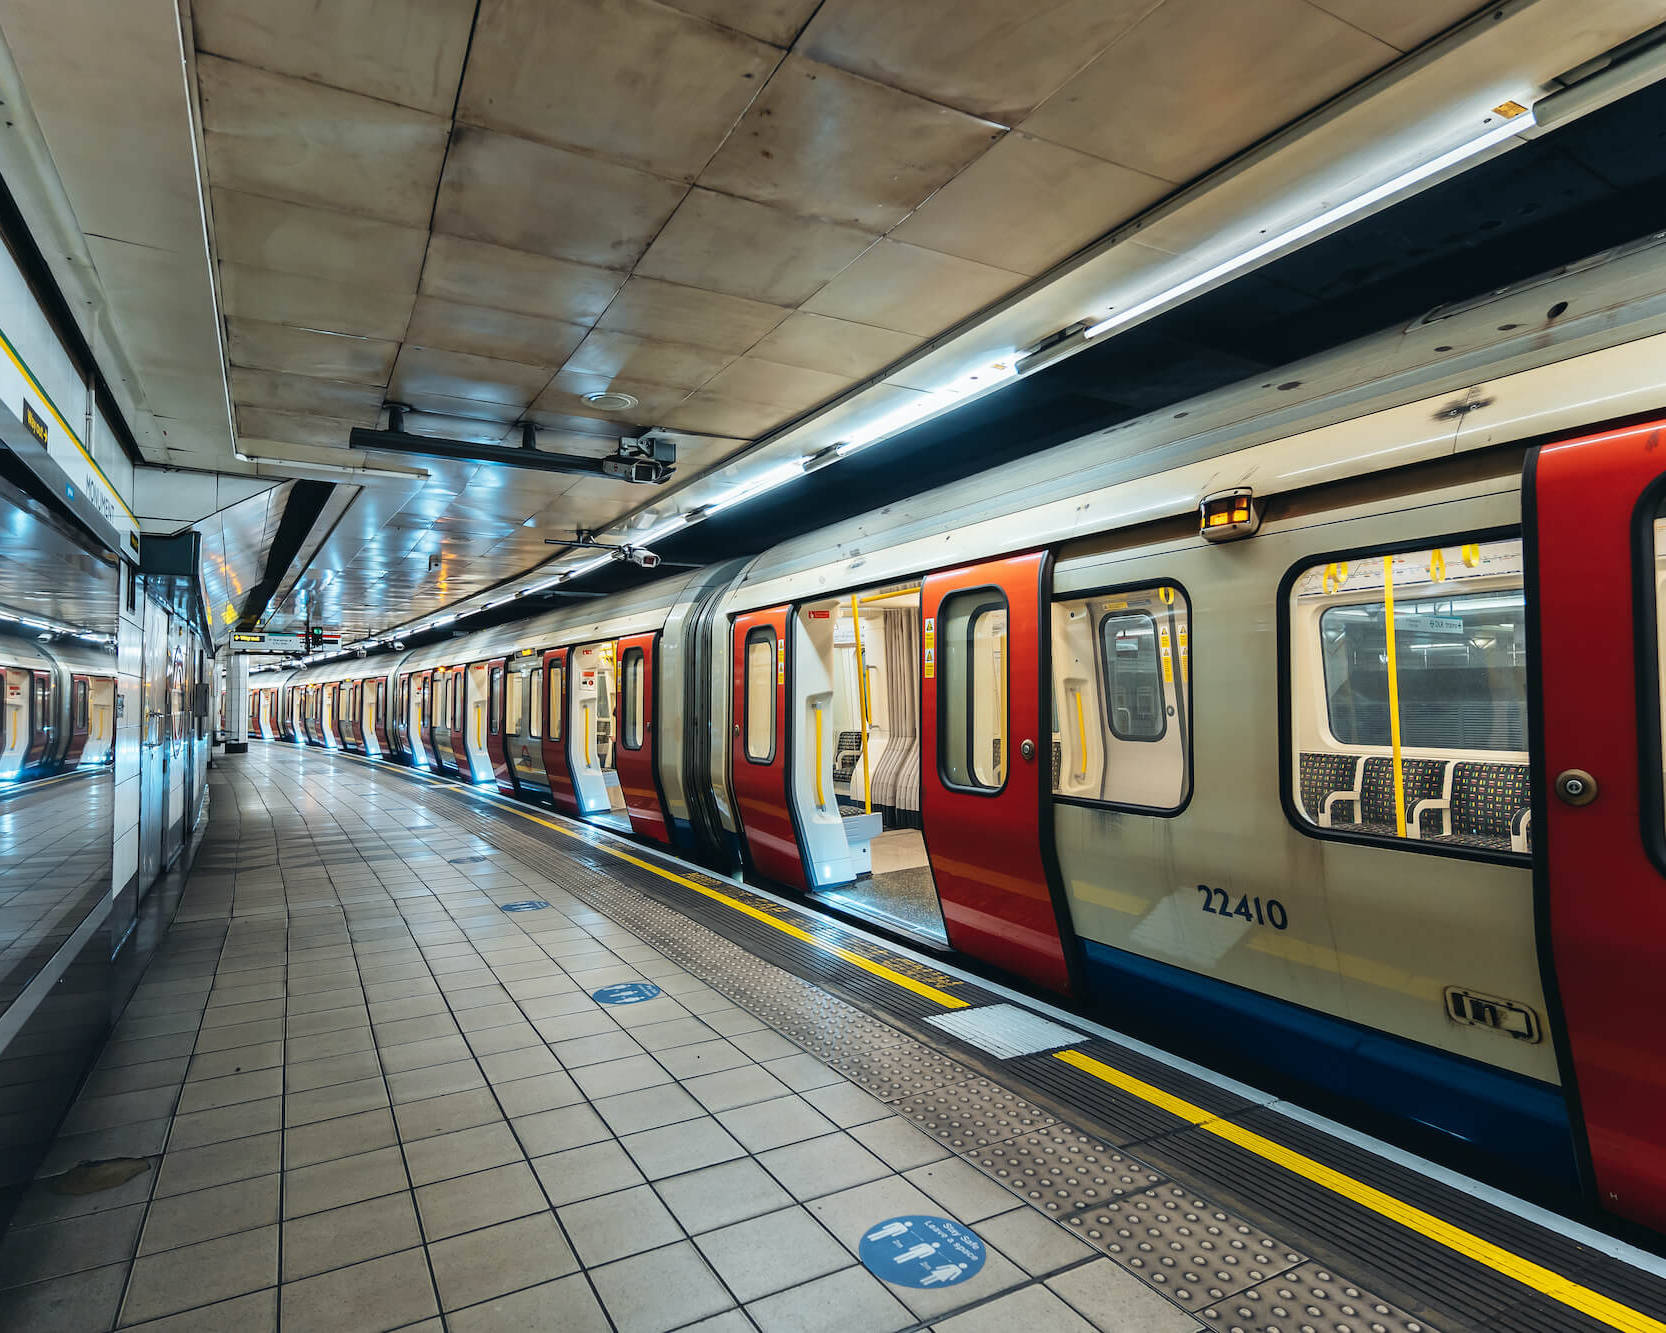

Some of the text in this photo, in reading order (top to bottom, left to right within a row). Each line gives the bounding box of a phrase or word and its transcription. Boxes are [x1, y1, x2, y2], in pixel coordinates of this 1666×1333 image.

[1197, 884, 1288, 930] 22410
[924, 1220, 948, 1238] Leave
[953, 1242, 978, 1261] space
[942, 1222, 980, 1250] Stay Safe
